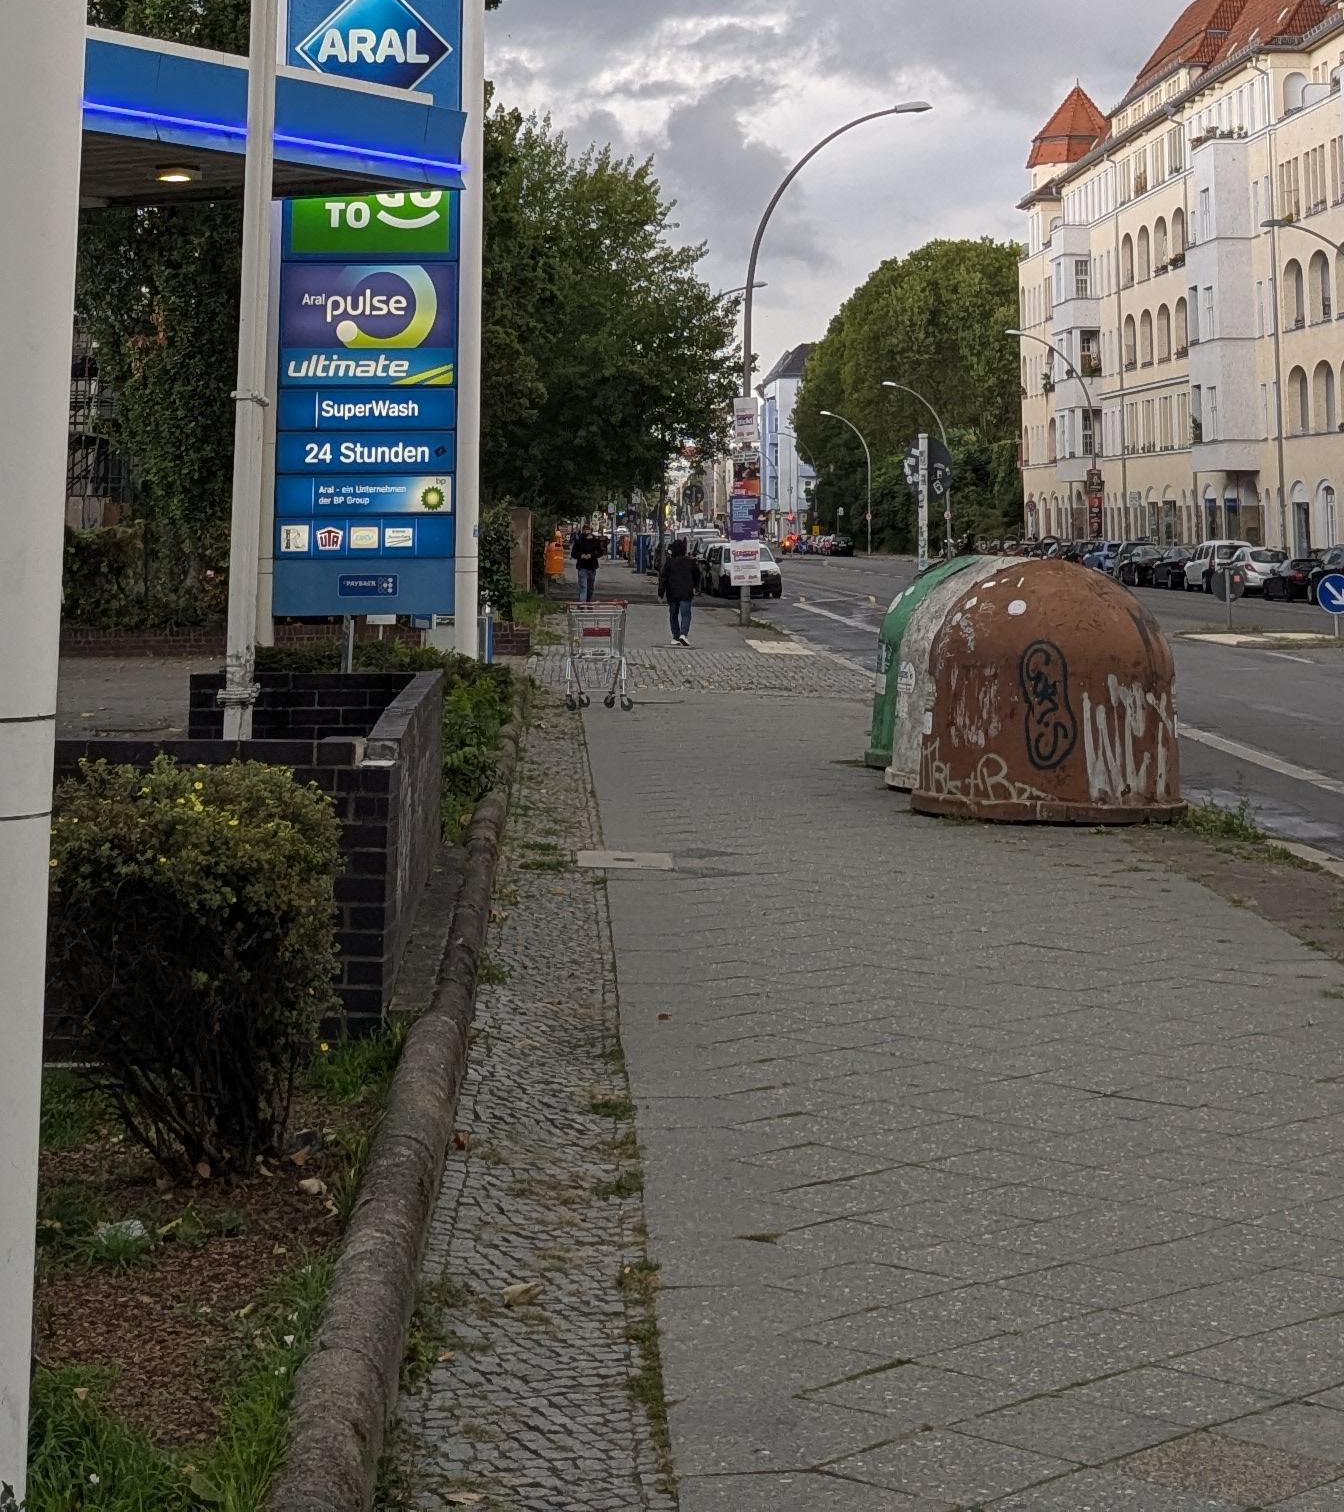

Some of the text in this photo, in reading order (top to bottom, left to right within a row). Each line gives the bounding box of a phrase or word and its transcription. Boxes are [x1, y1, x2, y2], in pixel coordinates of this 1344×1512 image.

[317, 28, 429, 64] ARAL
[325, 202, 370, 228] TO
[302, 289, 407, 322] Aral pulse
[287, 354, 409, 377] ultimate
[321, 400, 419, 420] SuperWash
[304, 442, 430, 463] 24 Stunden
[319, 486, 334, 494] Aral
[342, 486, 354, 494] ein
[355, 485, 406, 494] Unternehmen
[347, 497, 370, 505] Group
[318, 529, 342, 548] UTA
